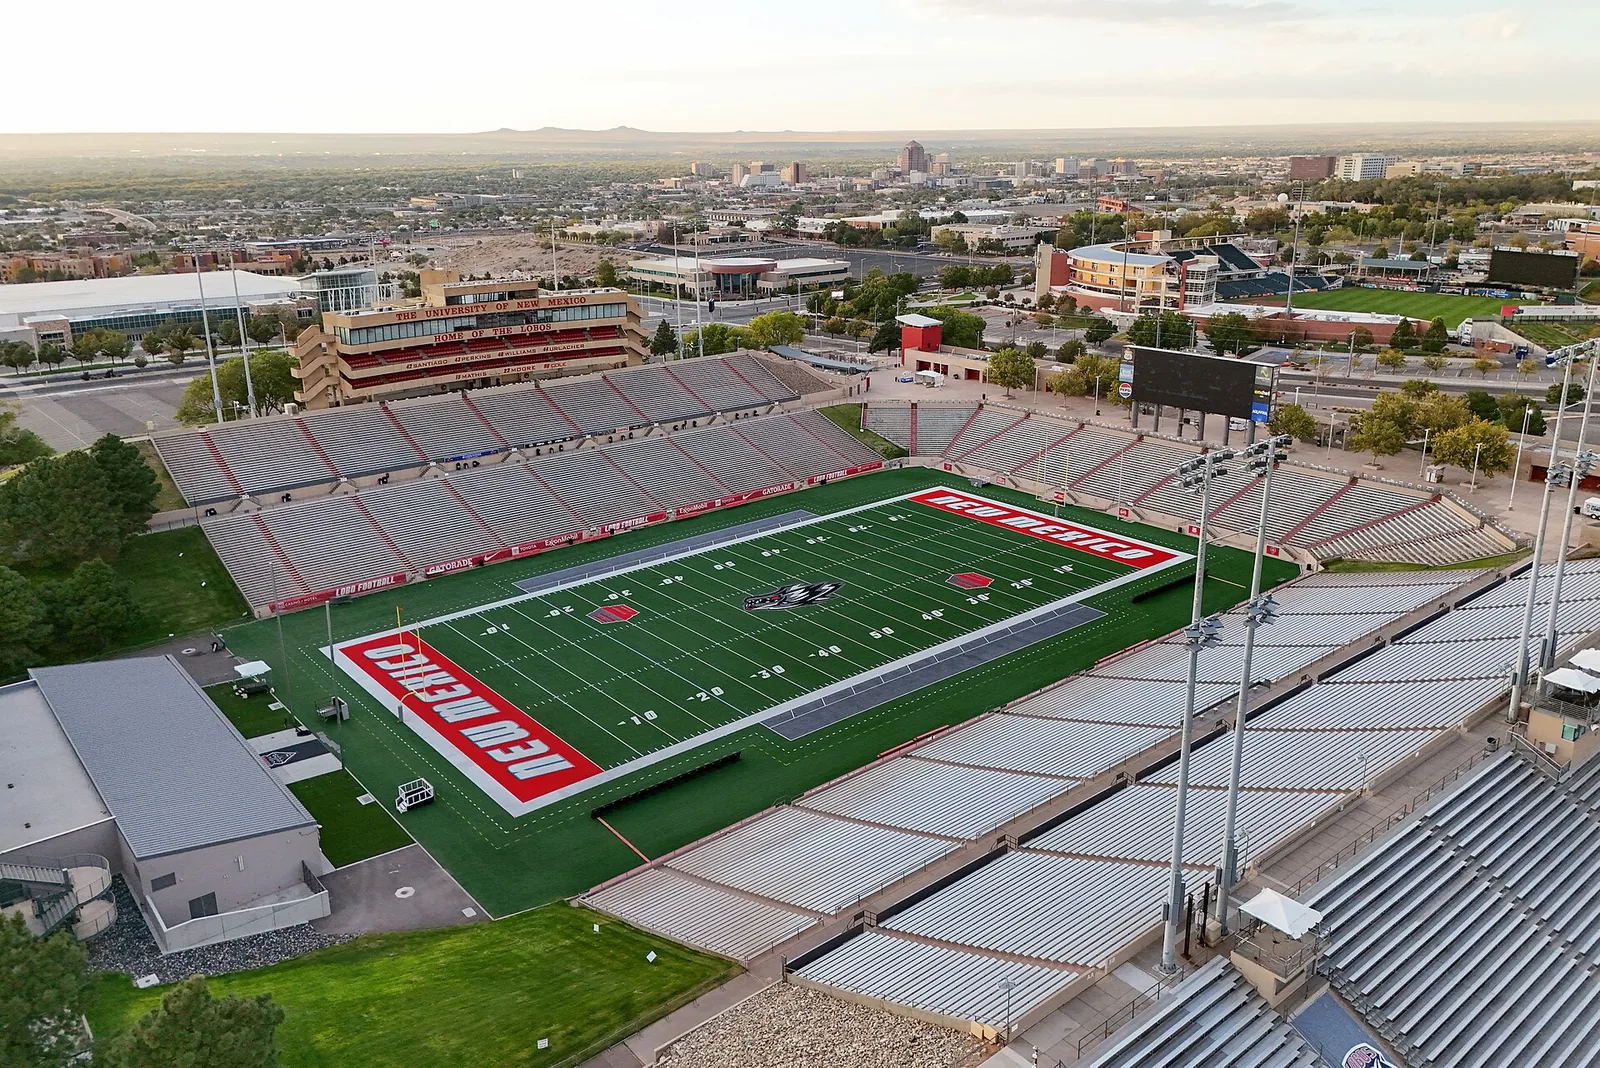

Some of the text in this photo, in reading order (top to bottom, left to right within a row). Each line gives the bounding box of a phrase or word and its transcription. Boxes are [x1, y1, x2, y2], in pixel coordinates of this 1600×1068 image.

[396, 296, 586, 321] THE UNIVERSITY OF NEW MEXICO
[434, 323, 552, 342] HOME OF THE LOBOS
[412, 359, 448, 369] SANTIAGO
[461, 353, 492, 362] PERKINS
[504, 348, 536, 357] WILLIAMS
[550, 343, 585, 352] URLACHER
[461, 371, 487, 379] MATHIS
[511, 365, 536, 373] MOORE
[825, 469, 848, 480] FOOTBALL
[762, 483, 792, 496] GATORADE
[621, 516, 649, 529] FOOTBALL
[888, 514, 906, 522] 10
[848, 524, 868, 533] 20
[925, 495, 1154, 560] NEW MEXICO
[544, 533, 578, 547] ExxonMobil
[806, 536, 827, 545] 30
[520, 544, 537, 552] TOYOTA
[761, 548, 780, 557] 40
[713, 560, 736, 570] 50
[1053, 565, 1072, 575] 10
[335, 575, 395, 597] LOBO FOOTBALL
[664, 575, 684, 585] 40
[1011, 579, 1031, 590] 20
[608, 589, 633, 600] 30
[965, 594, 990, 605] 30
[549, 605, 575, 617] 20
[921, 609, 944, 621] 40
[486, 623, 510, 635] 10
[868, 626, 895, 639] 50
[818, 645, 842, 658] 40
[757, 664, 786, 679] 30
[695, 686, 725, 702] 20
[362, 643, 575, 781] NEW MEXICO
[630, 710, 658, 726] 10
